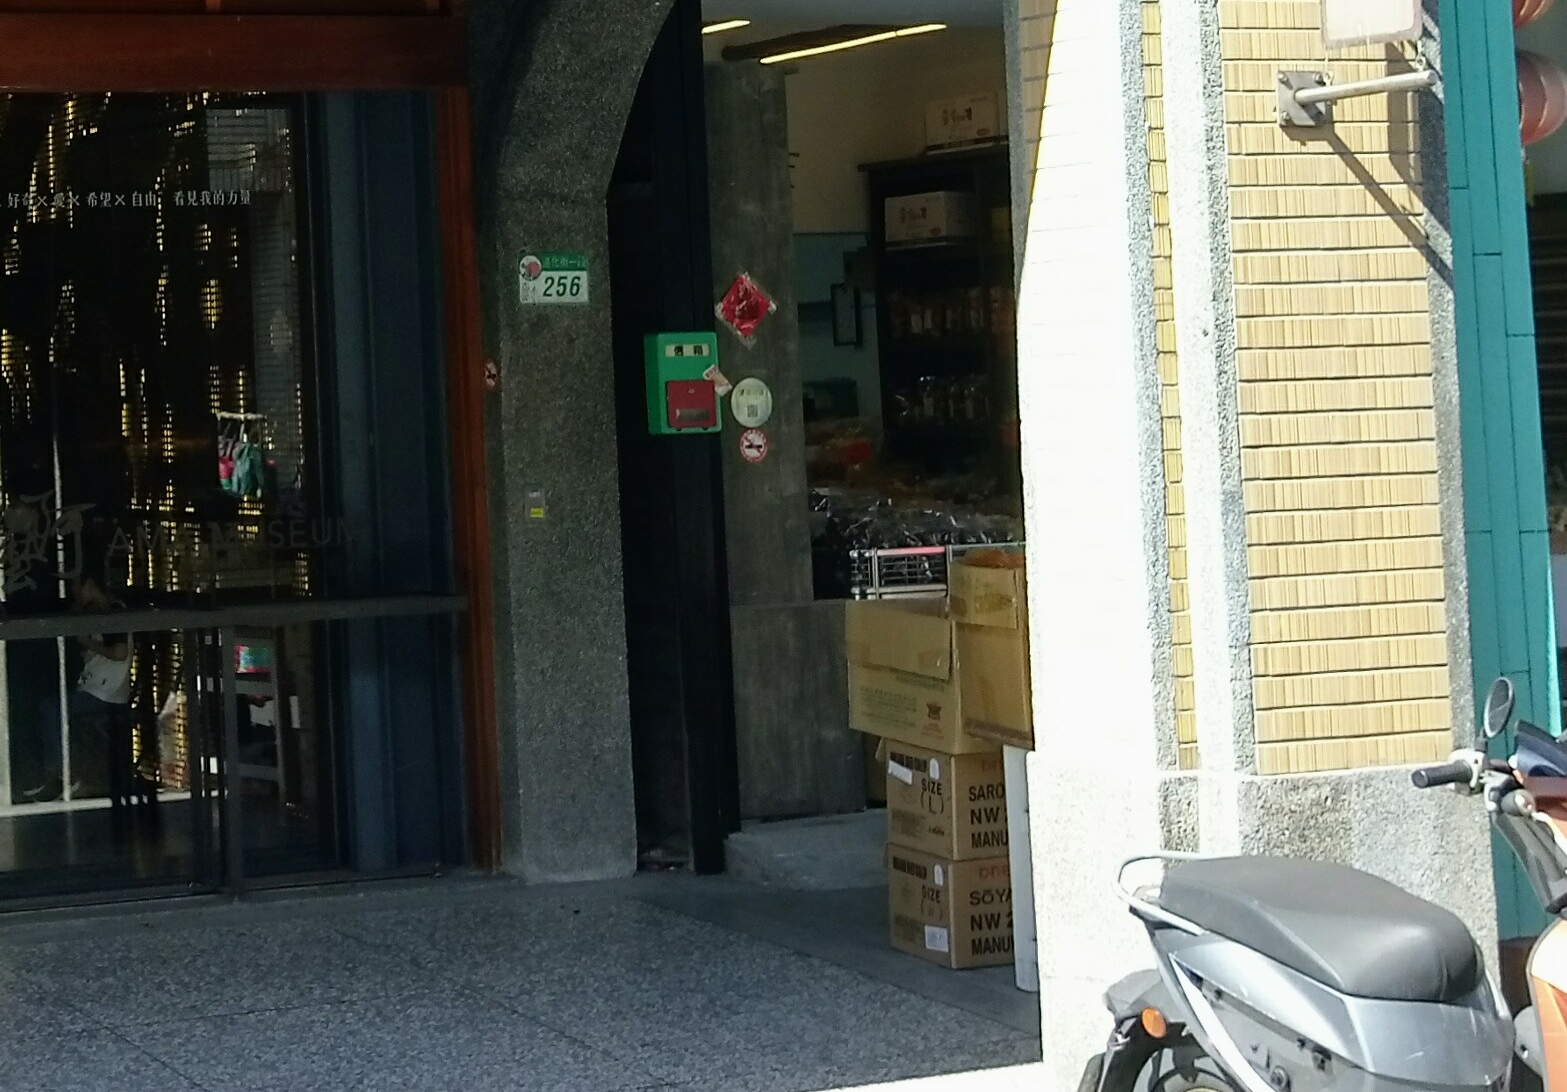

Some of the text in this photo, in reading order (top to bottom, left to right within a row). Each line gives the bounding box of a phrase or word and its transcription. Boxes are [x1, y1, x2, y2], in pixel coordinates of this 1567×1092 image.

[543, 276, 581, 297] 256
[921, 778, 943, 796] SIZE
[970, 807, 1000, 825] NW
[970, 912, 1001, 932] NW
